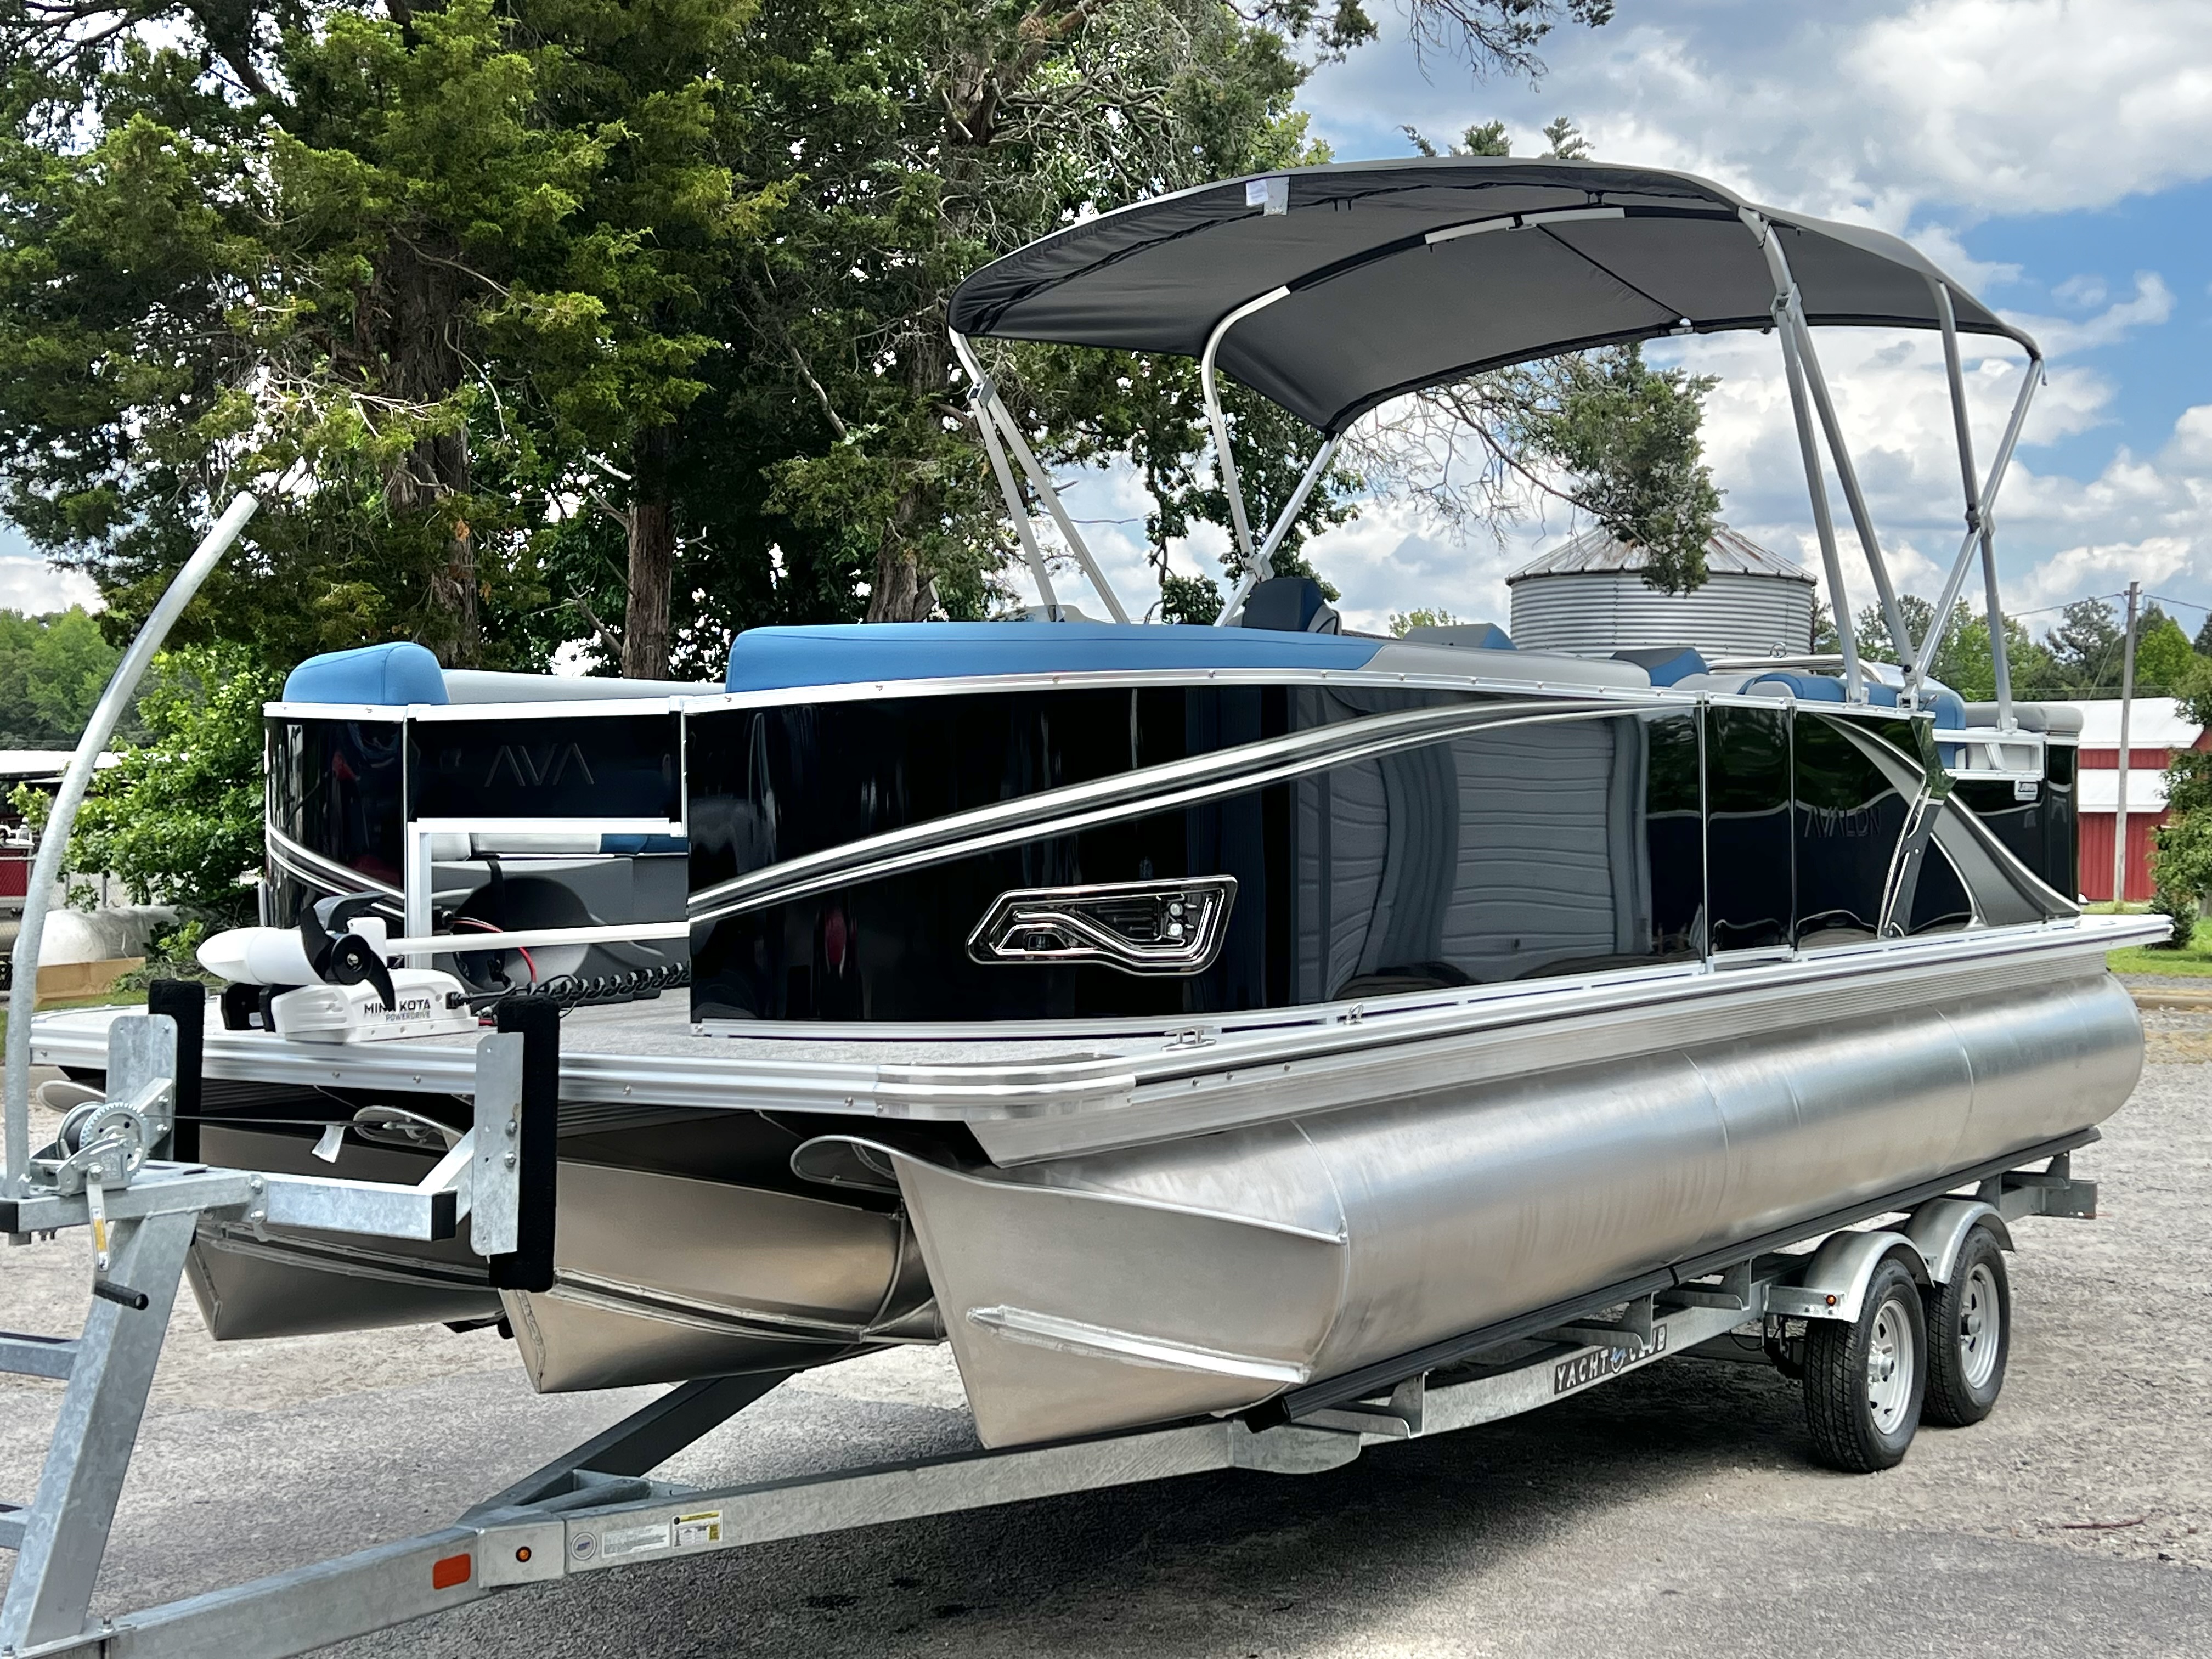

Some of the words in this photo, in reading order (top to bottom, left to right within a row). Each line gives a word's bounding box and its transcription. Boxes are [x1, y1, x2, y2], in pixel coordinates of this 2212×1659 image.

[484, 742, 594, 787] AVA
[1804, 806, 1881, 838] AVALON
[364, 1002, 394, 1014] MIN
[399, 998, 431, 1011] KOTA
[1557, 1349, 1609, 1391] YACHT
